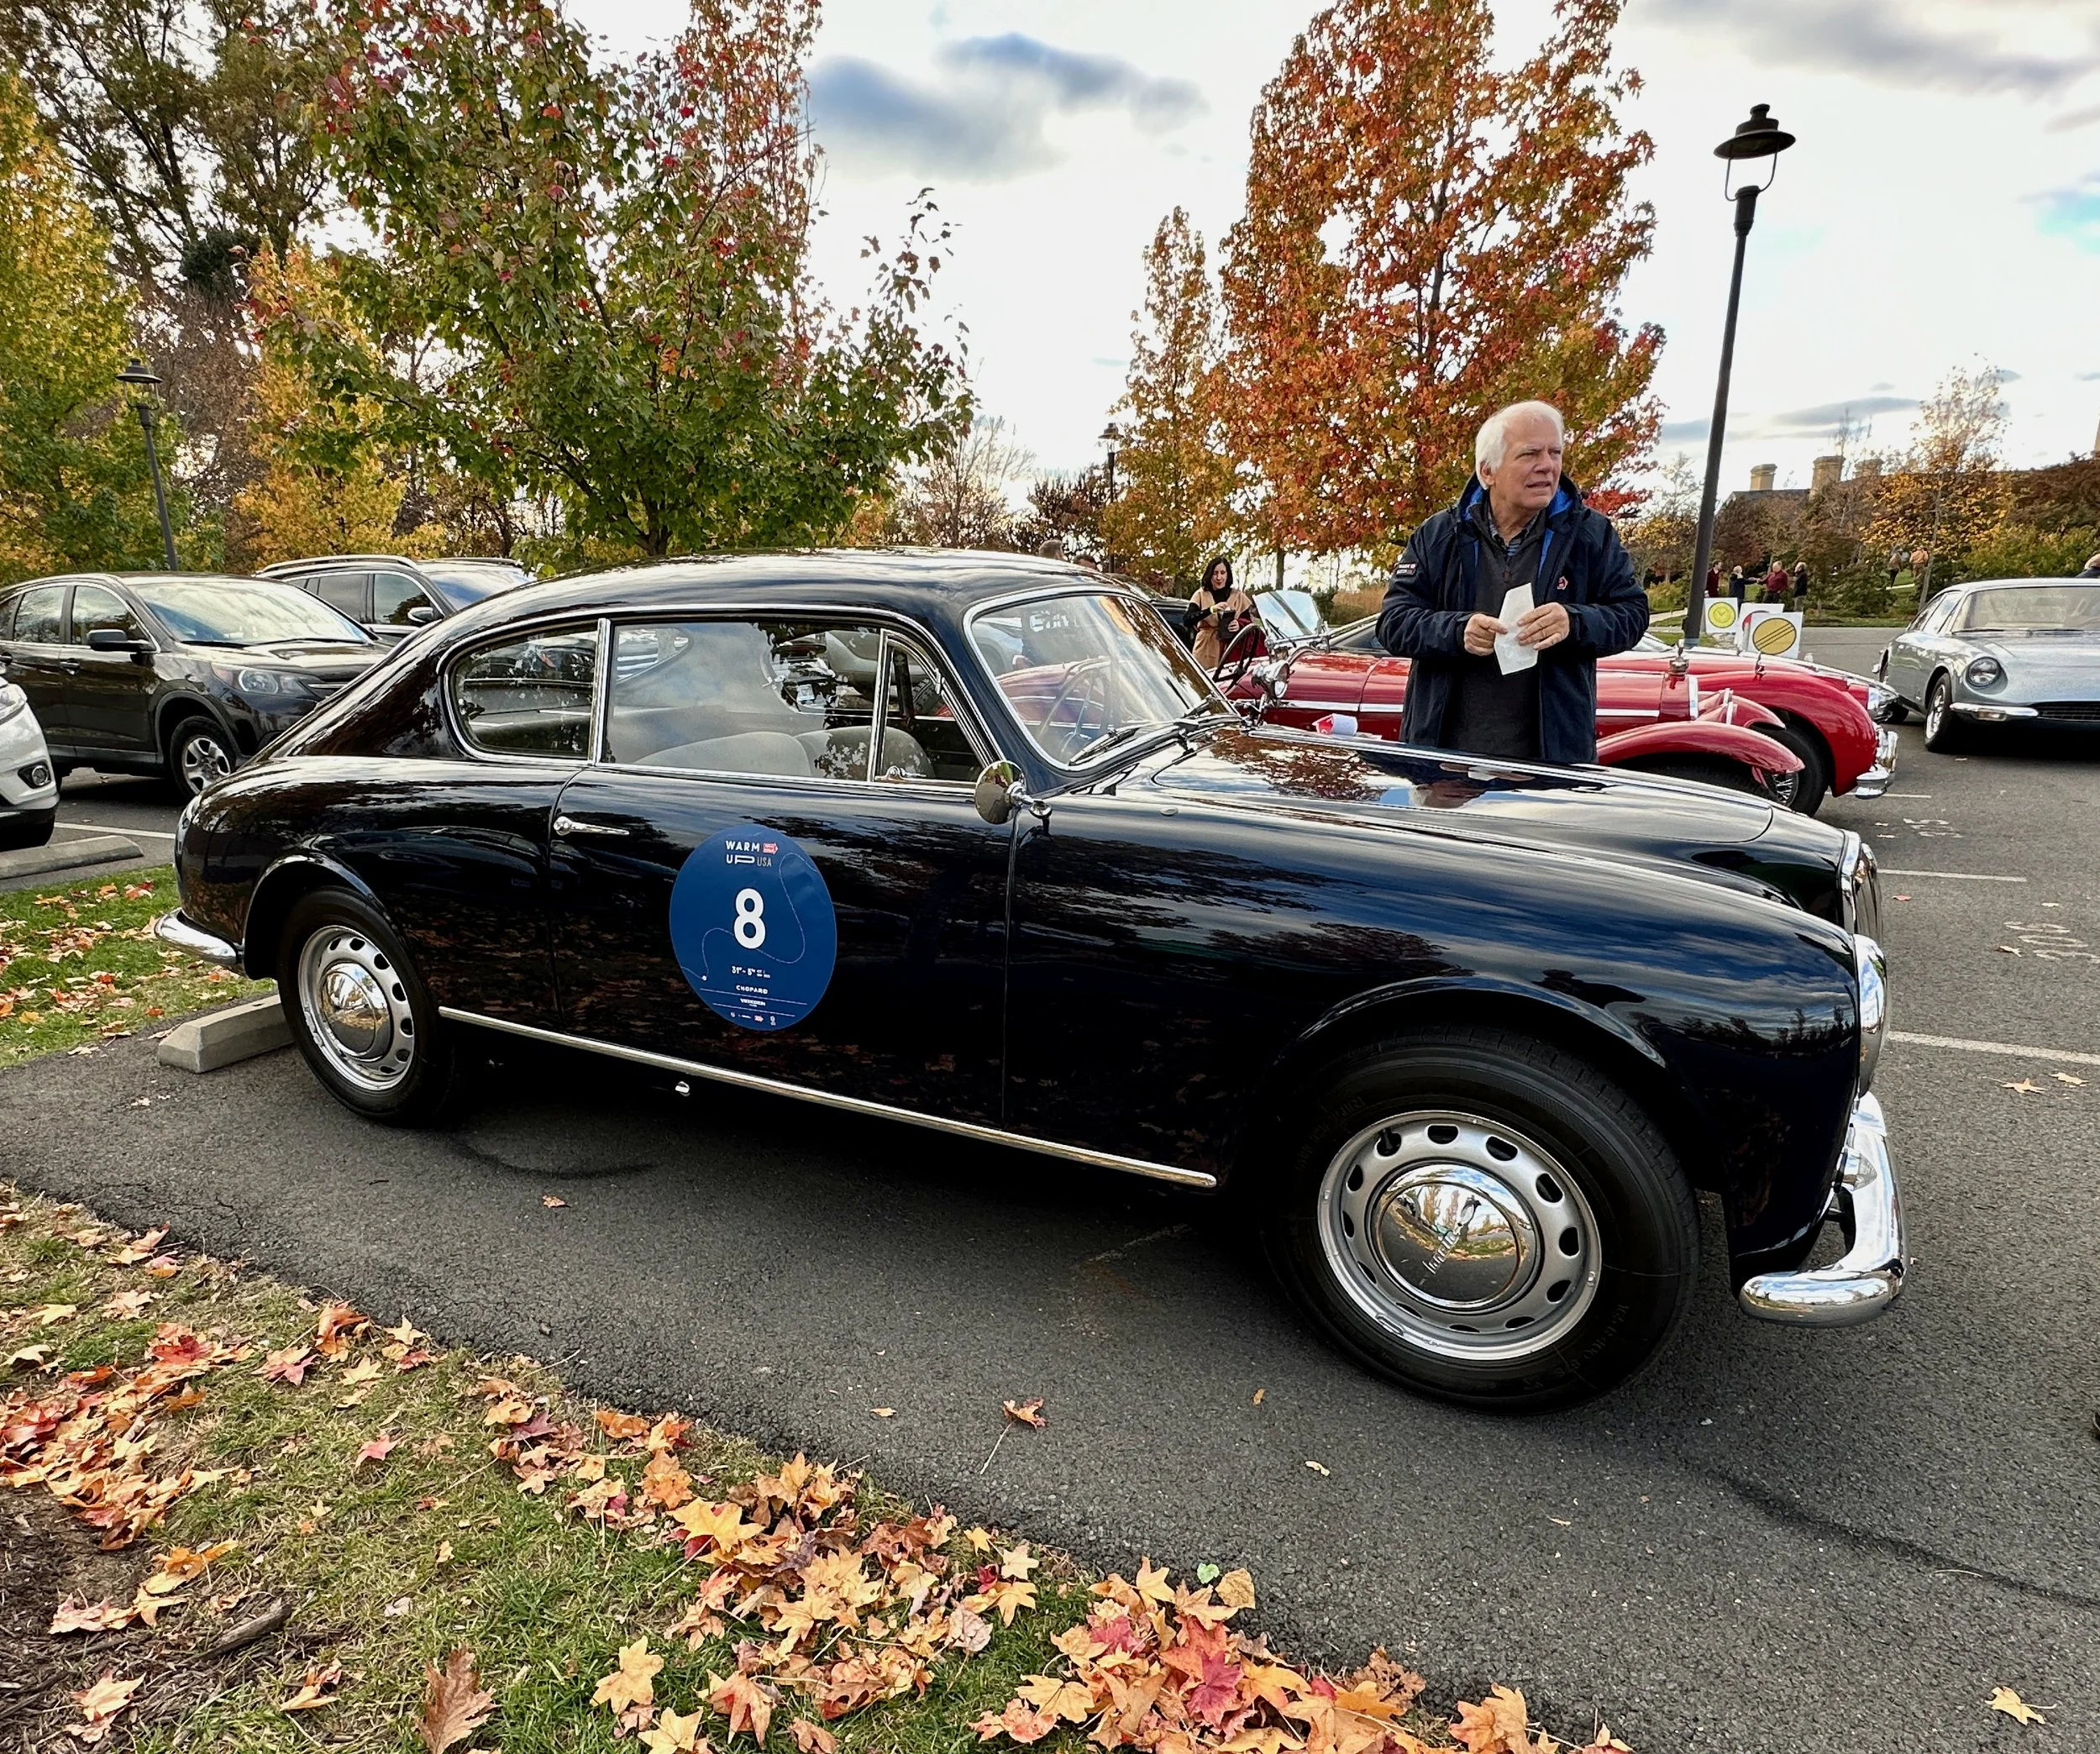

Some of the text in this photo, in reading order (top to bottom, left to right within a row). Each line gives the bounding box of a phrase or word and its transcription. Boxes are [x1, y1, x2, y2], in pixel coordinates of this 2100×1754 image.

[725, 840, 760, 853] WARM
[726, 853, 772, 868] UP USA
[733, 888, 766, 949] 8
[736, 985, 769, 995] CHOPARD
